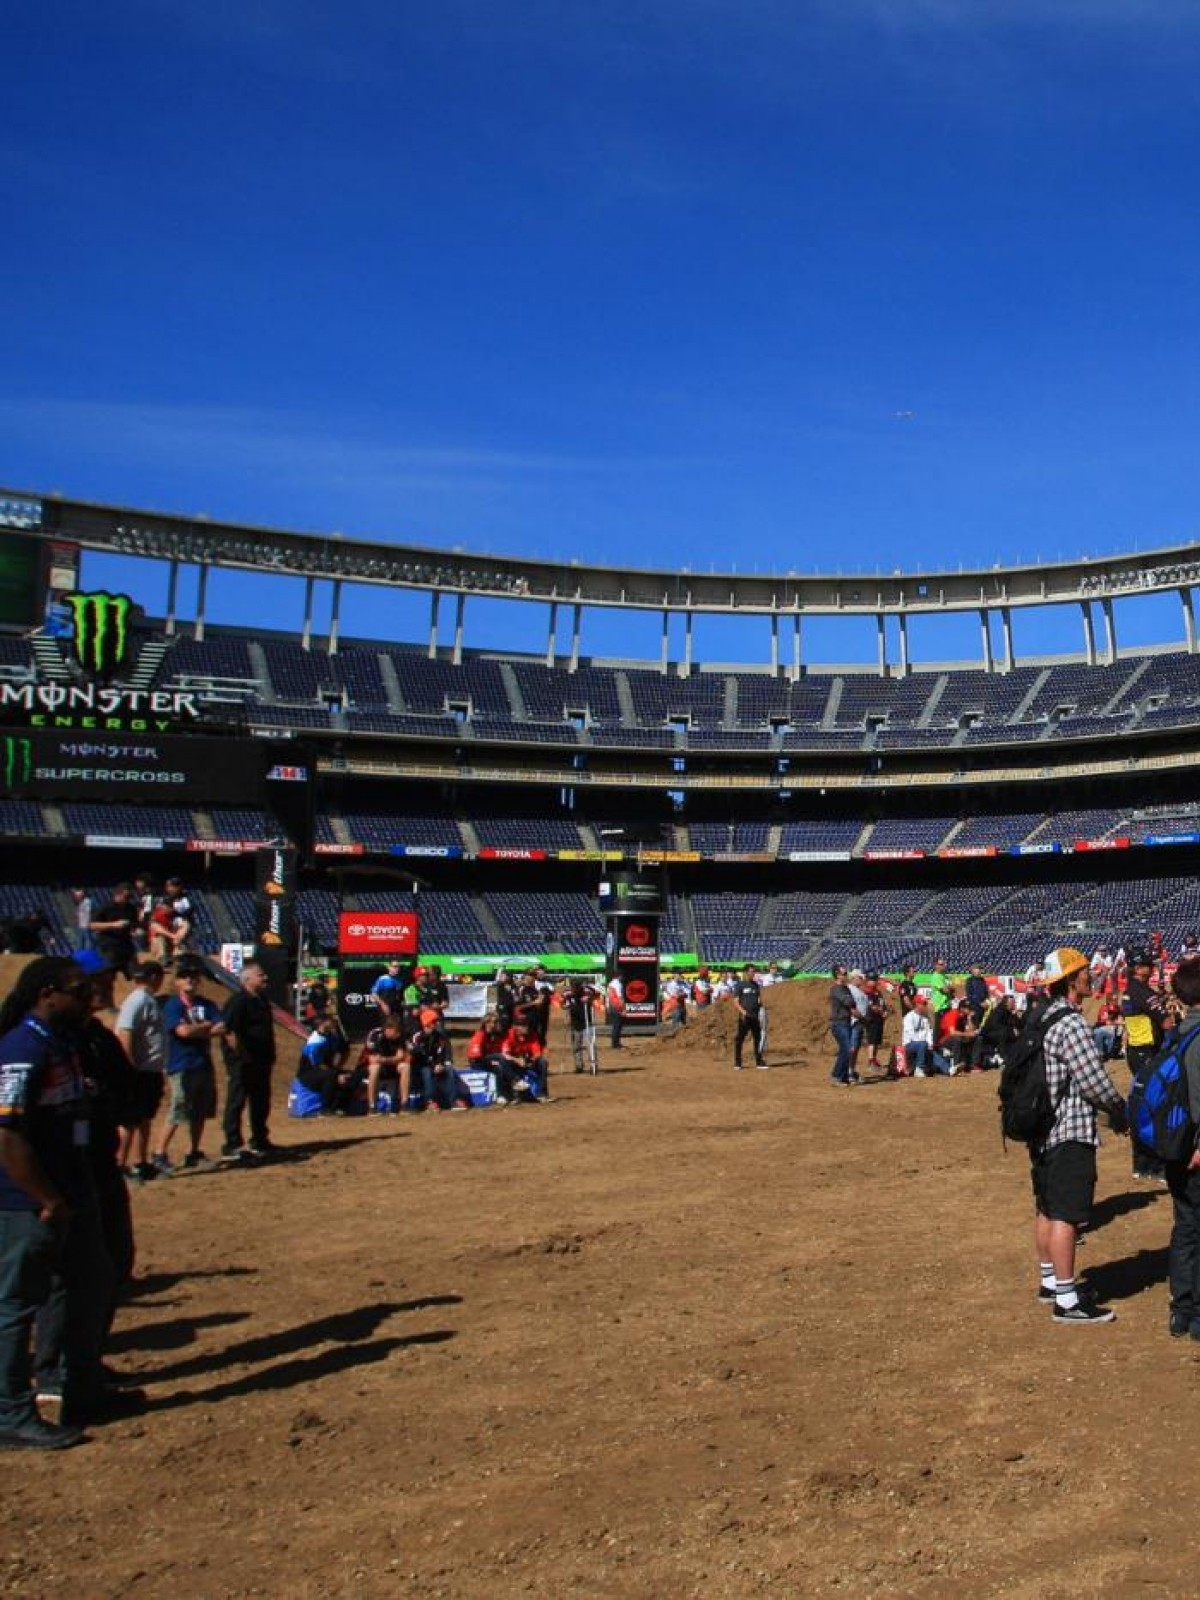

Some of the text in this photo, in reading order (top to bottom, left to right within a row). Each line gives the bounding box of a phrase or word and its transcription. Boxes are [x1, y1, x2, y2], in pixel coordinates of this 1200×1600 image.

[30, 714, 170, 731] ENERGY
[35, 767, 186, 783] SUPERCROSS
[495, 850, 531, 858] TOYOTA
[367, 925, 410, 935] TOYOTA
